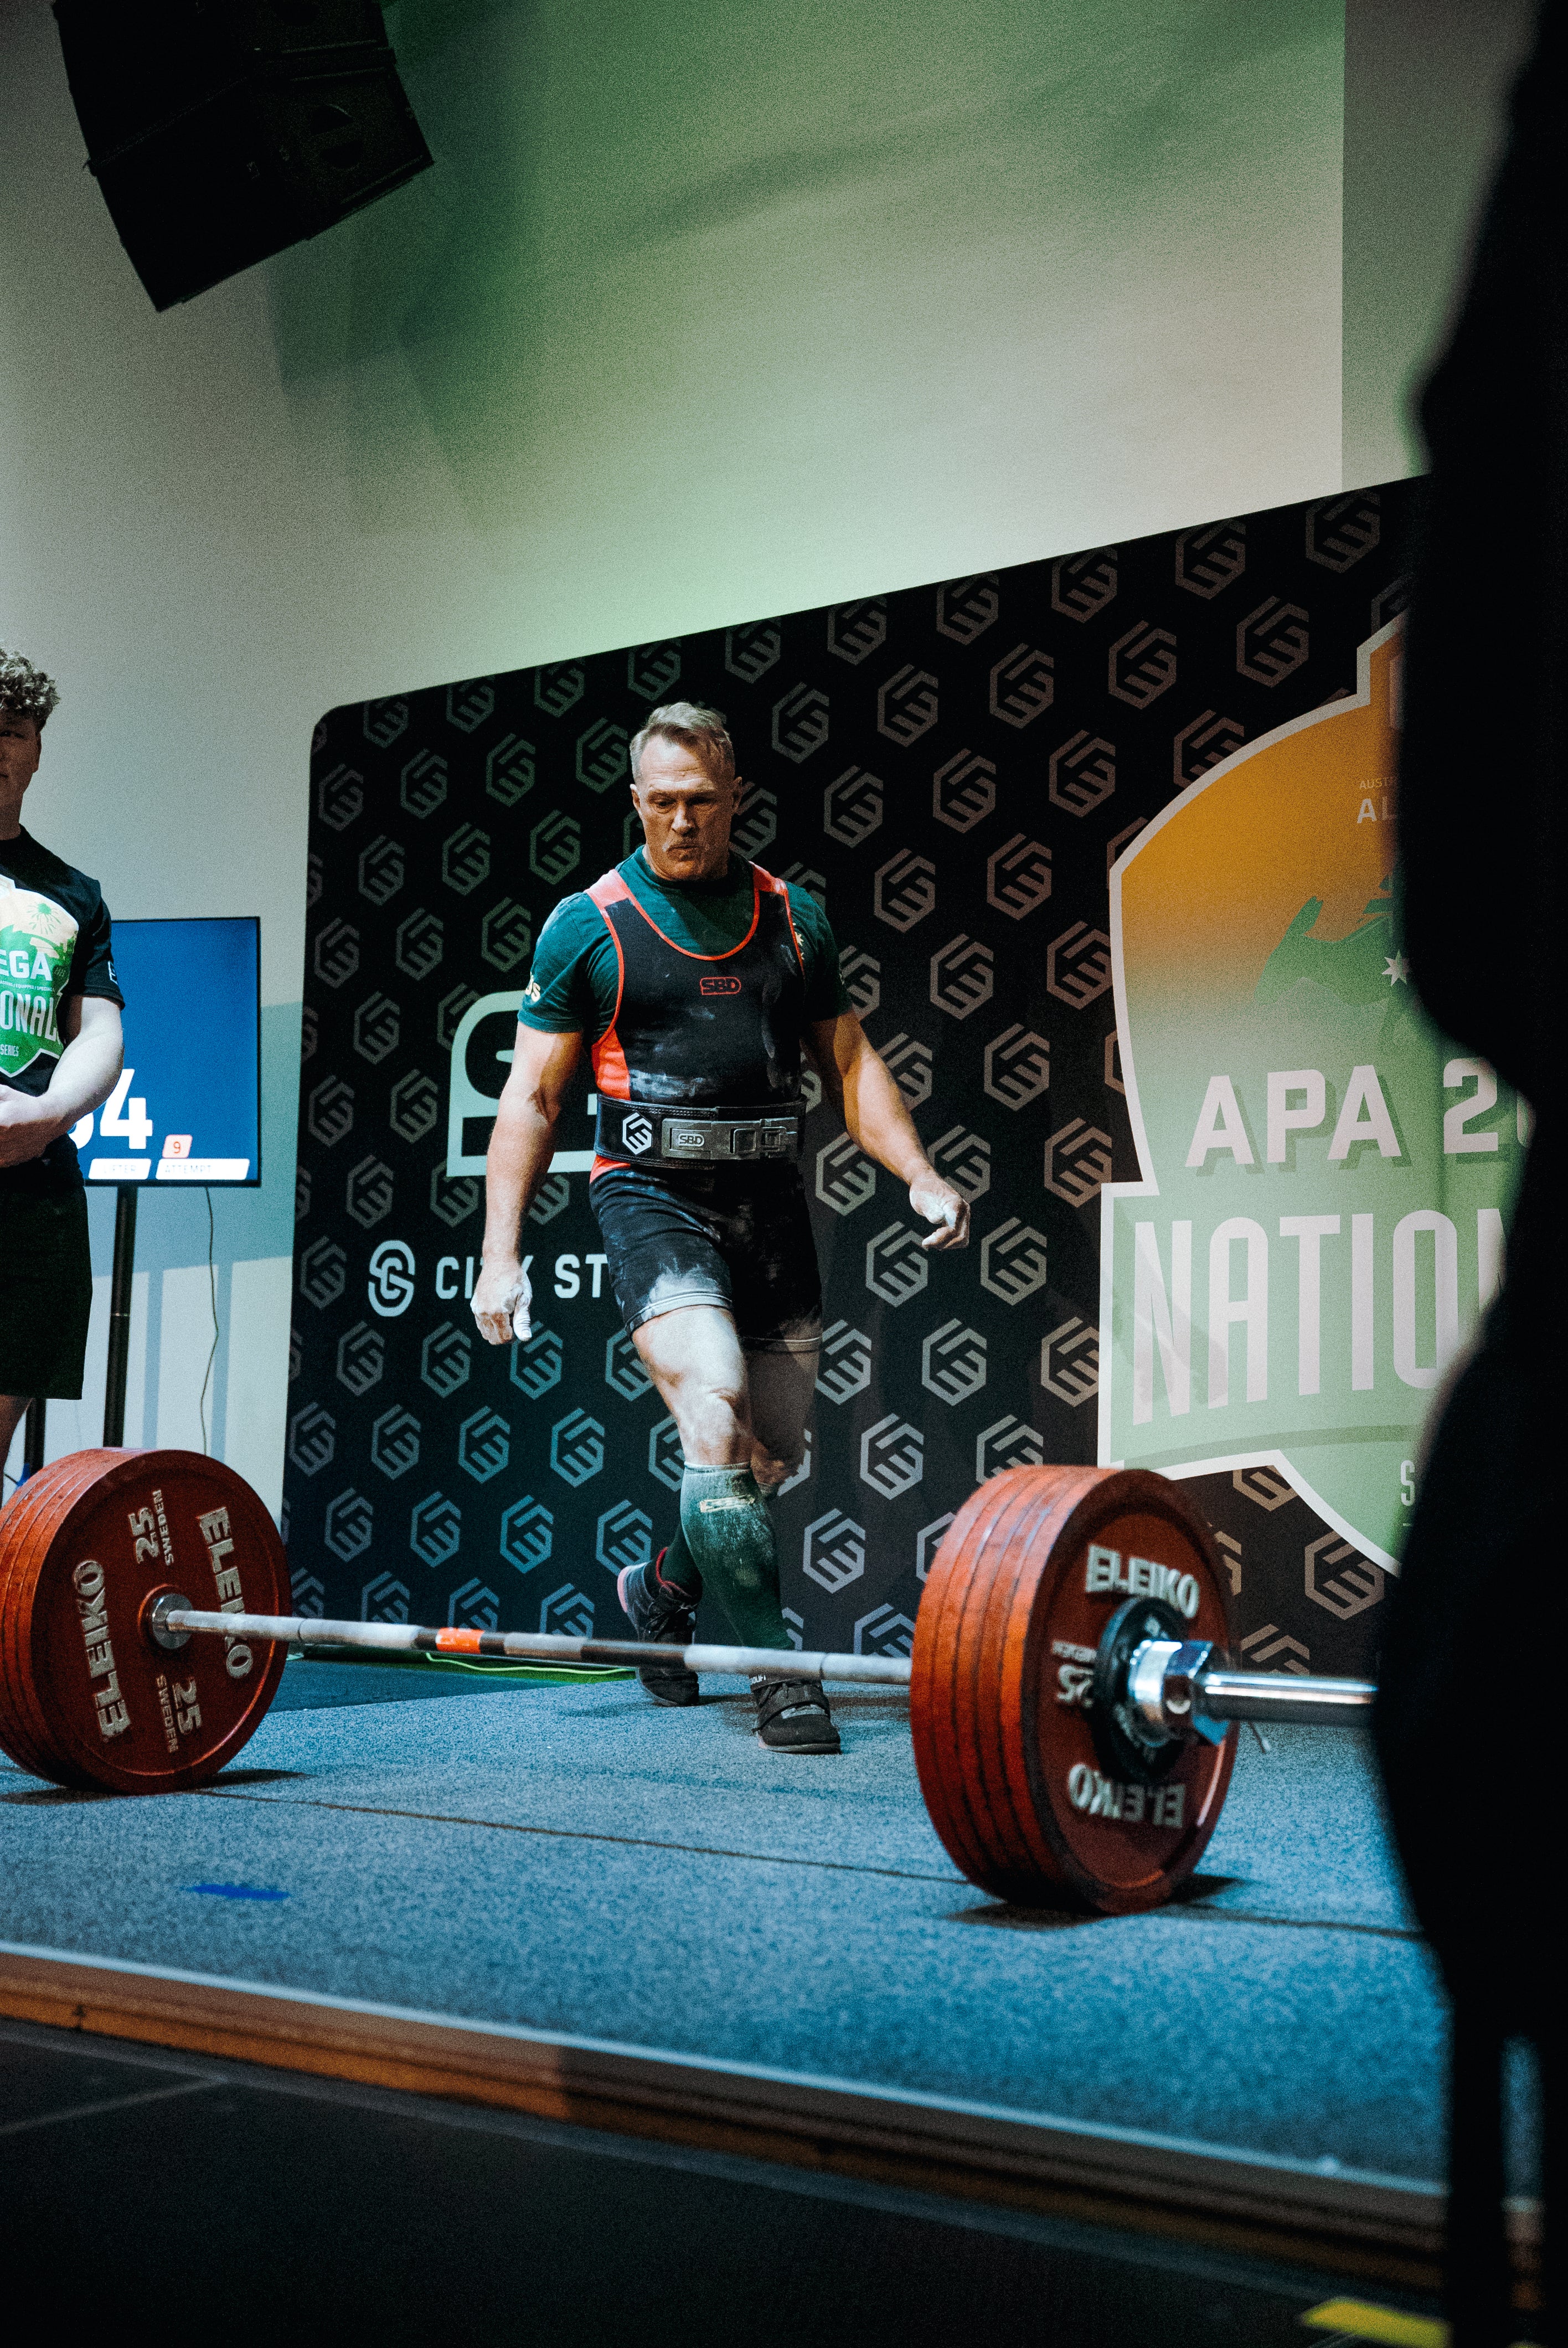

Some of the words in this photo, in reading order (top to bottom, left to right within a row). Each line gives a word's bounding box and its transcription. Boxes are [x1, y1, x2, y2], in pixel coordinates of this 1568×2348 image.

[700, 976, 741, 995] SBD
[0, 990, 60, 1044] ONAL
[1, 1044, 19, 1057] SERIES
[678, 1134, 705, 1147] SBD
[1185, 1064, 1402, 1168] APA
[104, 1165, 137, 1174] LFTER
[165, 1165, 212, 1174] ATTEMPT
[173, 1141, 180, 1154] 9
[436, 1255, 534, 1300] CI
[554, 1254, 608, 1299] ST
[127, 1507, 159, 1564] 25
[153, 1490, 174, 1566] SWEDEN
[198, 1507, 254, 1680] ELEIO
[1086, 1543, 1200, 1619] ELEIKO
[72, 1559, 131, 1741] ELEIKO
[156, 1675, 179, 1753] SWEDEN
[172, 1678, 202, 1736] 25
[1069, 1763, 1186, 1828] ELEIKO
